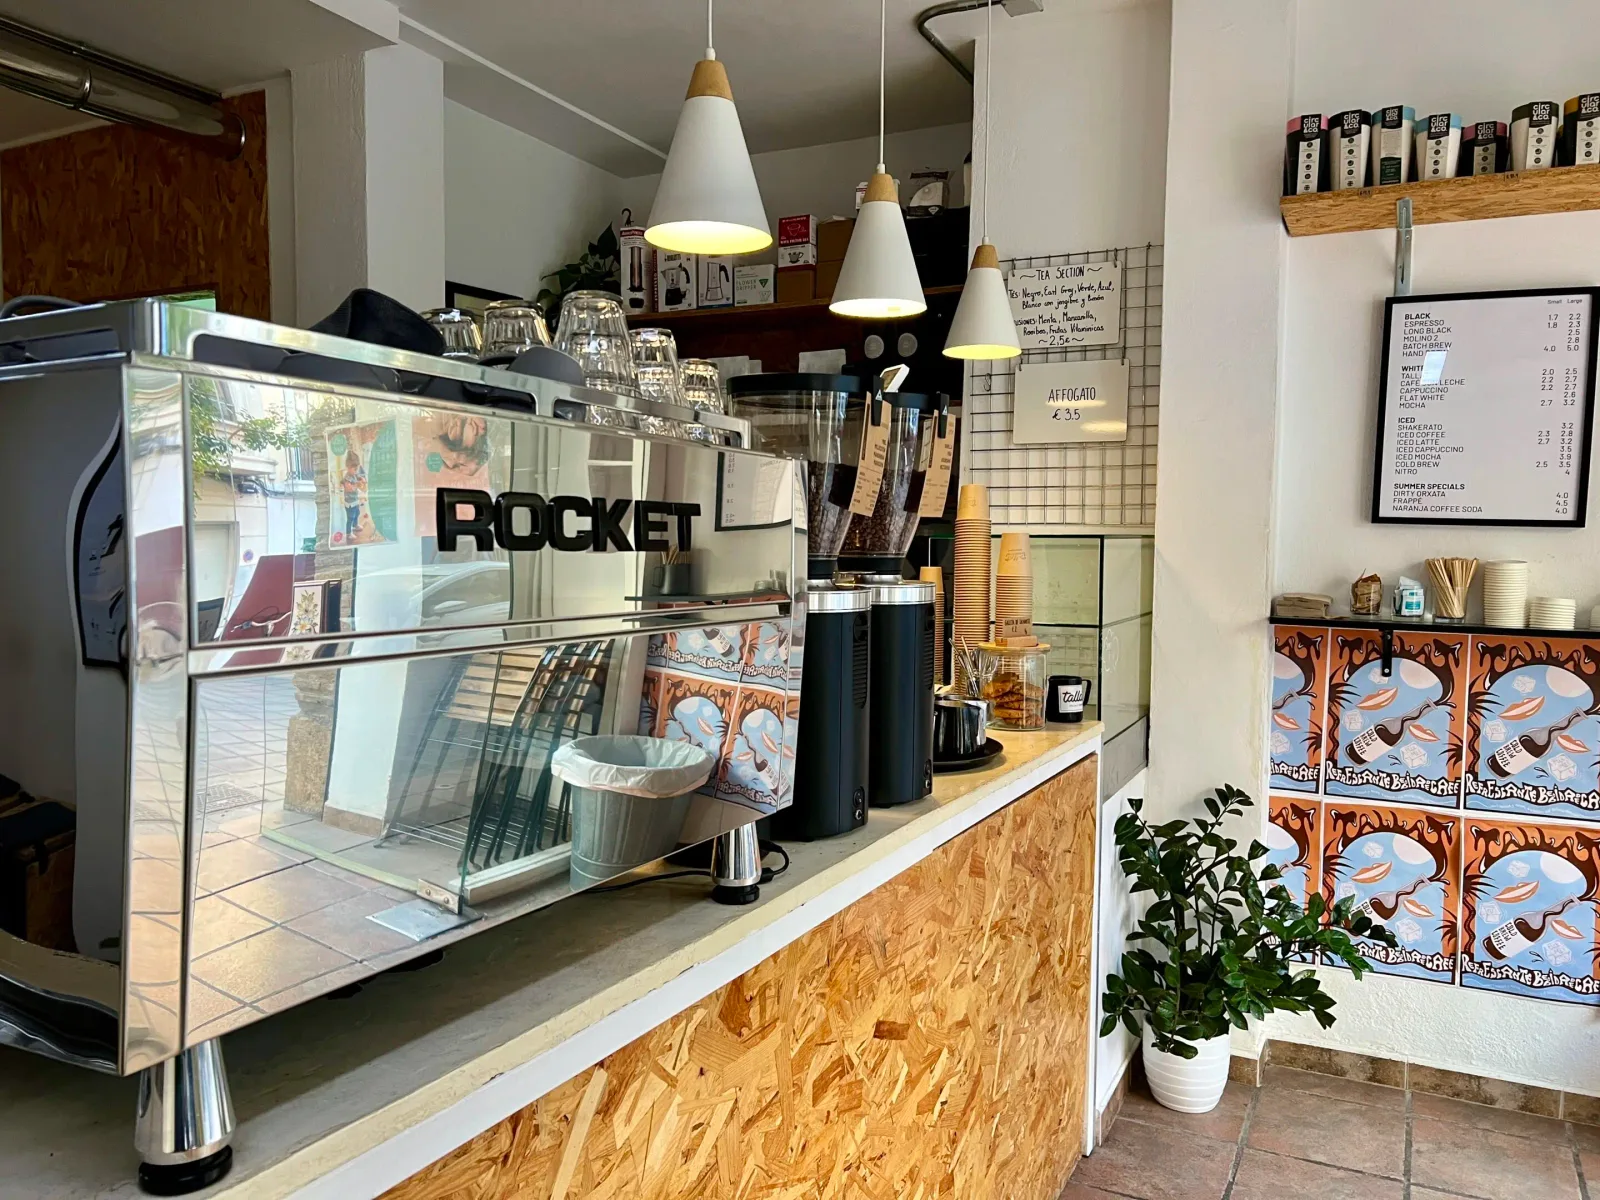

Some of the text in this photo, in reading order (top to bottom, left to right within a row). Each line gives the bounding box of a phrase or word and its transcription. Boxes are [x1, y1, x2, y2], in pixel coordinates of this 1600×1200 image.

[1036, 266, 1084, 280] TEA SECTION
[1022, 288, 1043, 301] Negro,
[1044, 285, 1057, 296] Earl
[1077, 282, 1096, 292] Verde,
[1098, 281, 1114, 292] Azul,
[1022, 301, 1041, 310] Blanco
[1081, 298, 1085, 308] y
[1038, 313, 1060, 324] Menta,
[1049, 325, 1067, 334] Frutas
[1048, 387, 1096, 403] AFFOGATO
[1064, 409, 1080, 421] 3.5
[436, 487, 702, 552] ROCKET
[1360, 733, 1372, 746] BREW
[1367, 729, 1377, 742] COLD
[1354, 737, 1366, 755] COFFEE
[1503, 745, 1516, 758] BREW
[1510, 740, 1522, 753] COLD
[1496, 749, 1510, 767] COFFEE
[1362, 902, 1372, 914] COLD
[1499, 927, 1511, 941] BREW
[1505, 922, 1517, 936] COLD
[1492, 930, 1506, 950] COFFEE
